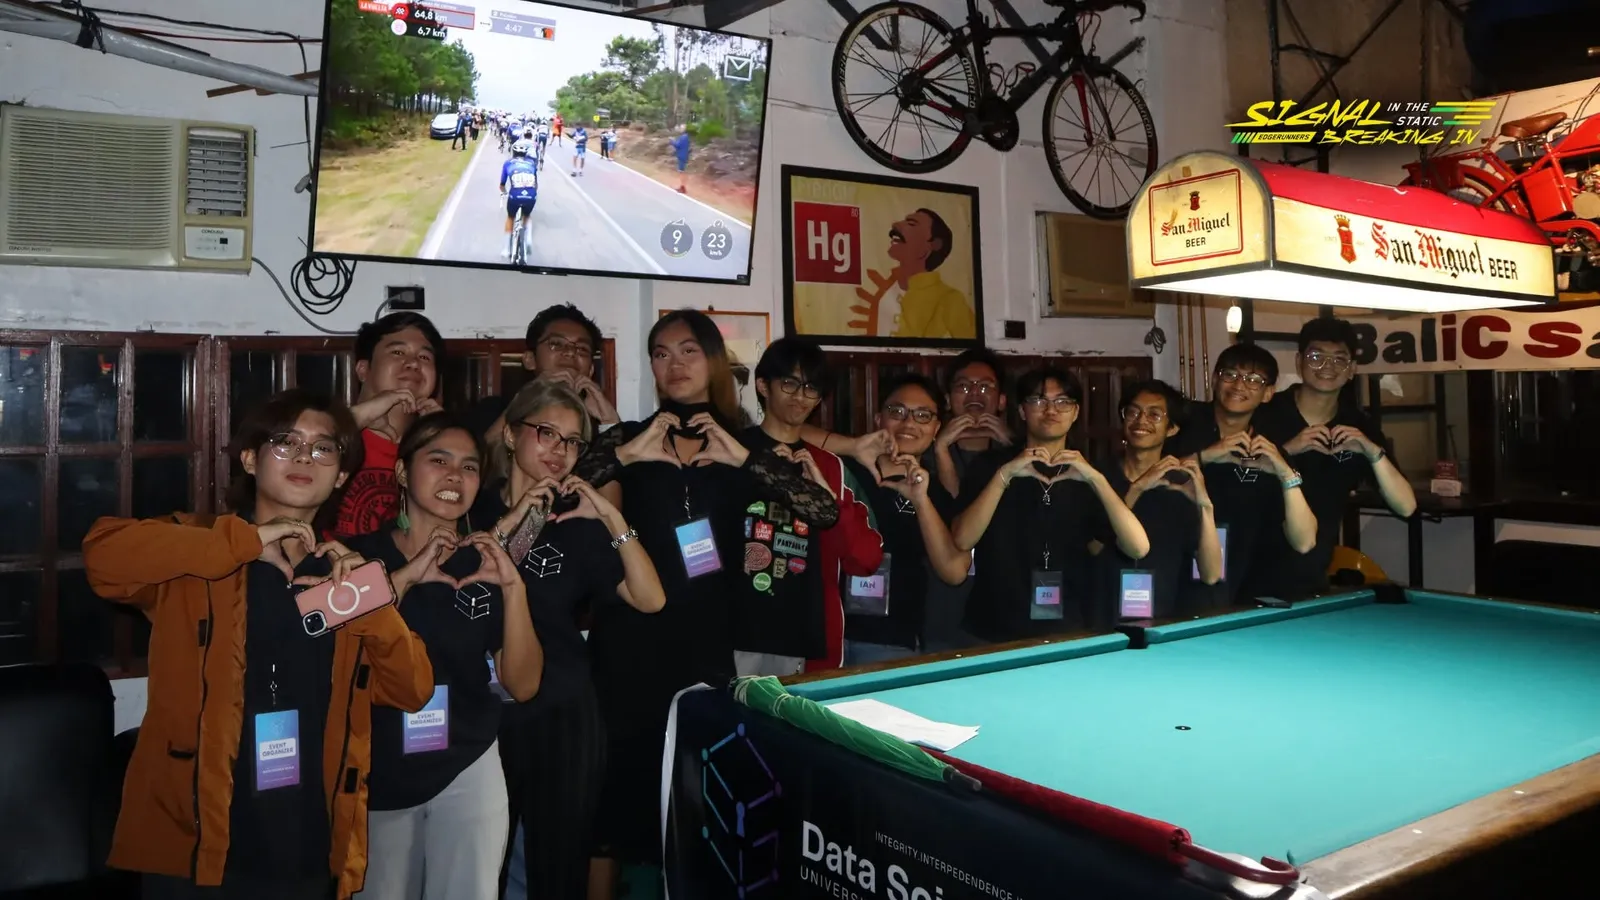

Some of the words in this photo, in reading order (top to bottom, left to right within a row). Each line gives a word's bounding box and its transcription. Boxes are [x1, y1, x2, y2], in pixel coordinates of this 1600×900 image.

[414, 9, 433, 20] 64,8
[434, 12, 448, 22] km
[417, 26, 431, 36] 6,7
[432, 28, 446, 37] km
[504, 23, 523, 33] 4:47
[1160, 220, 1186, 237] San
[1187, 212, 1231, 234] Miguel
[672, 229, 682, 245] 9
[707, 232, 726, 249] 23
[1186, 236, 1206, 248] BEER
[806, 219, 851, 273] Hg
[1370, 221, 1416, 268] San
[1414, 229, 1485, 279] Miguel
[1488, 257, 1519, 281] BEER
[410, 716, 443, 726] ORGANIZER
[417, 712, 436, 720] EVENT
[262, 747, 294, 758] ORGANIZER
[268, 742, 287, 751] EVENT
[802, 820, 876, 894] Data
